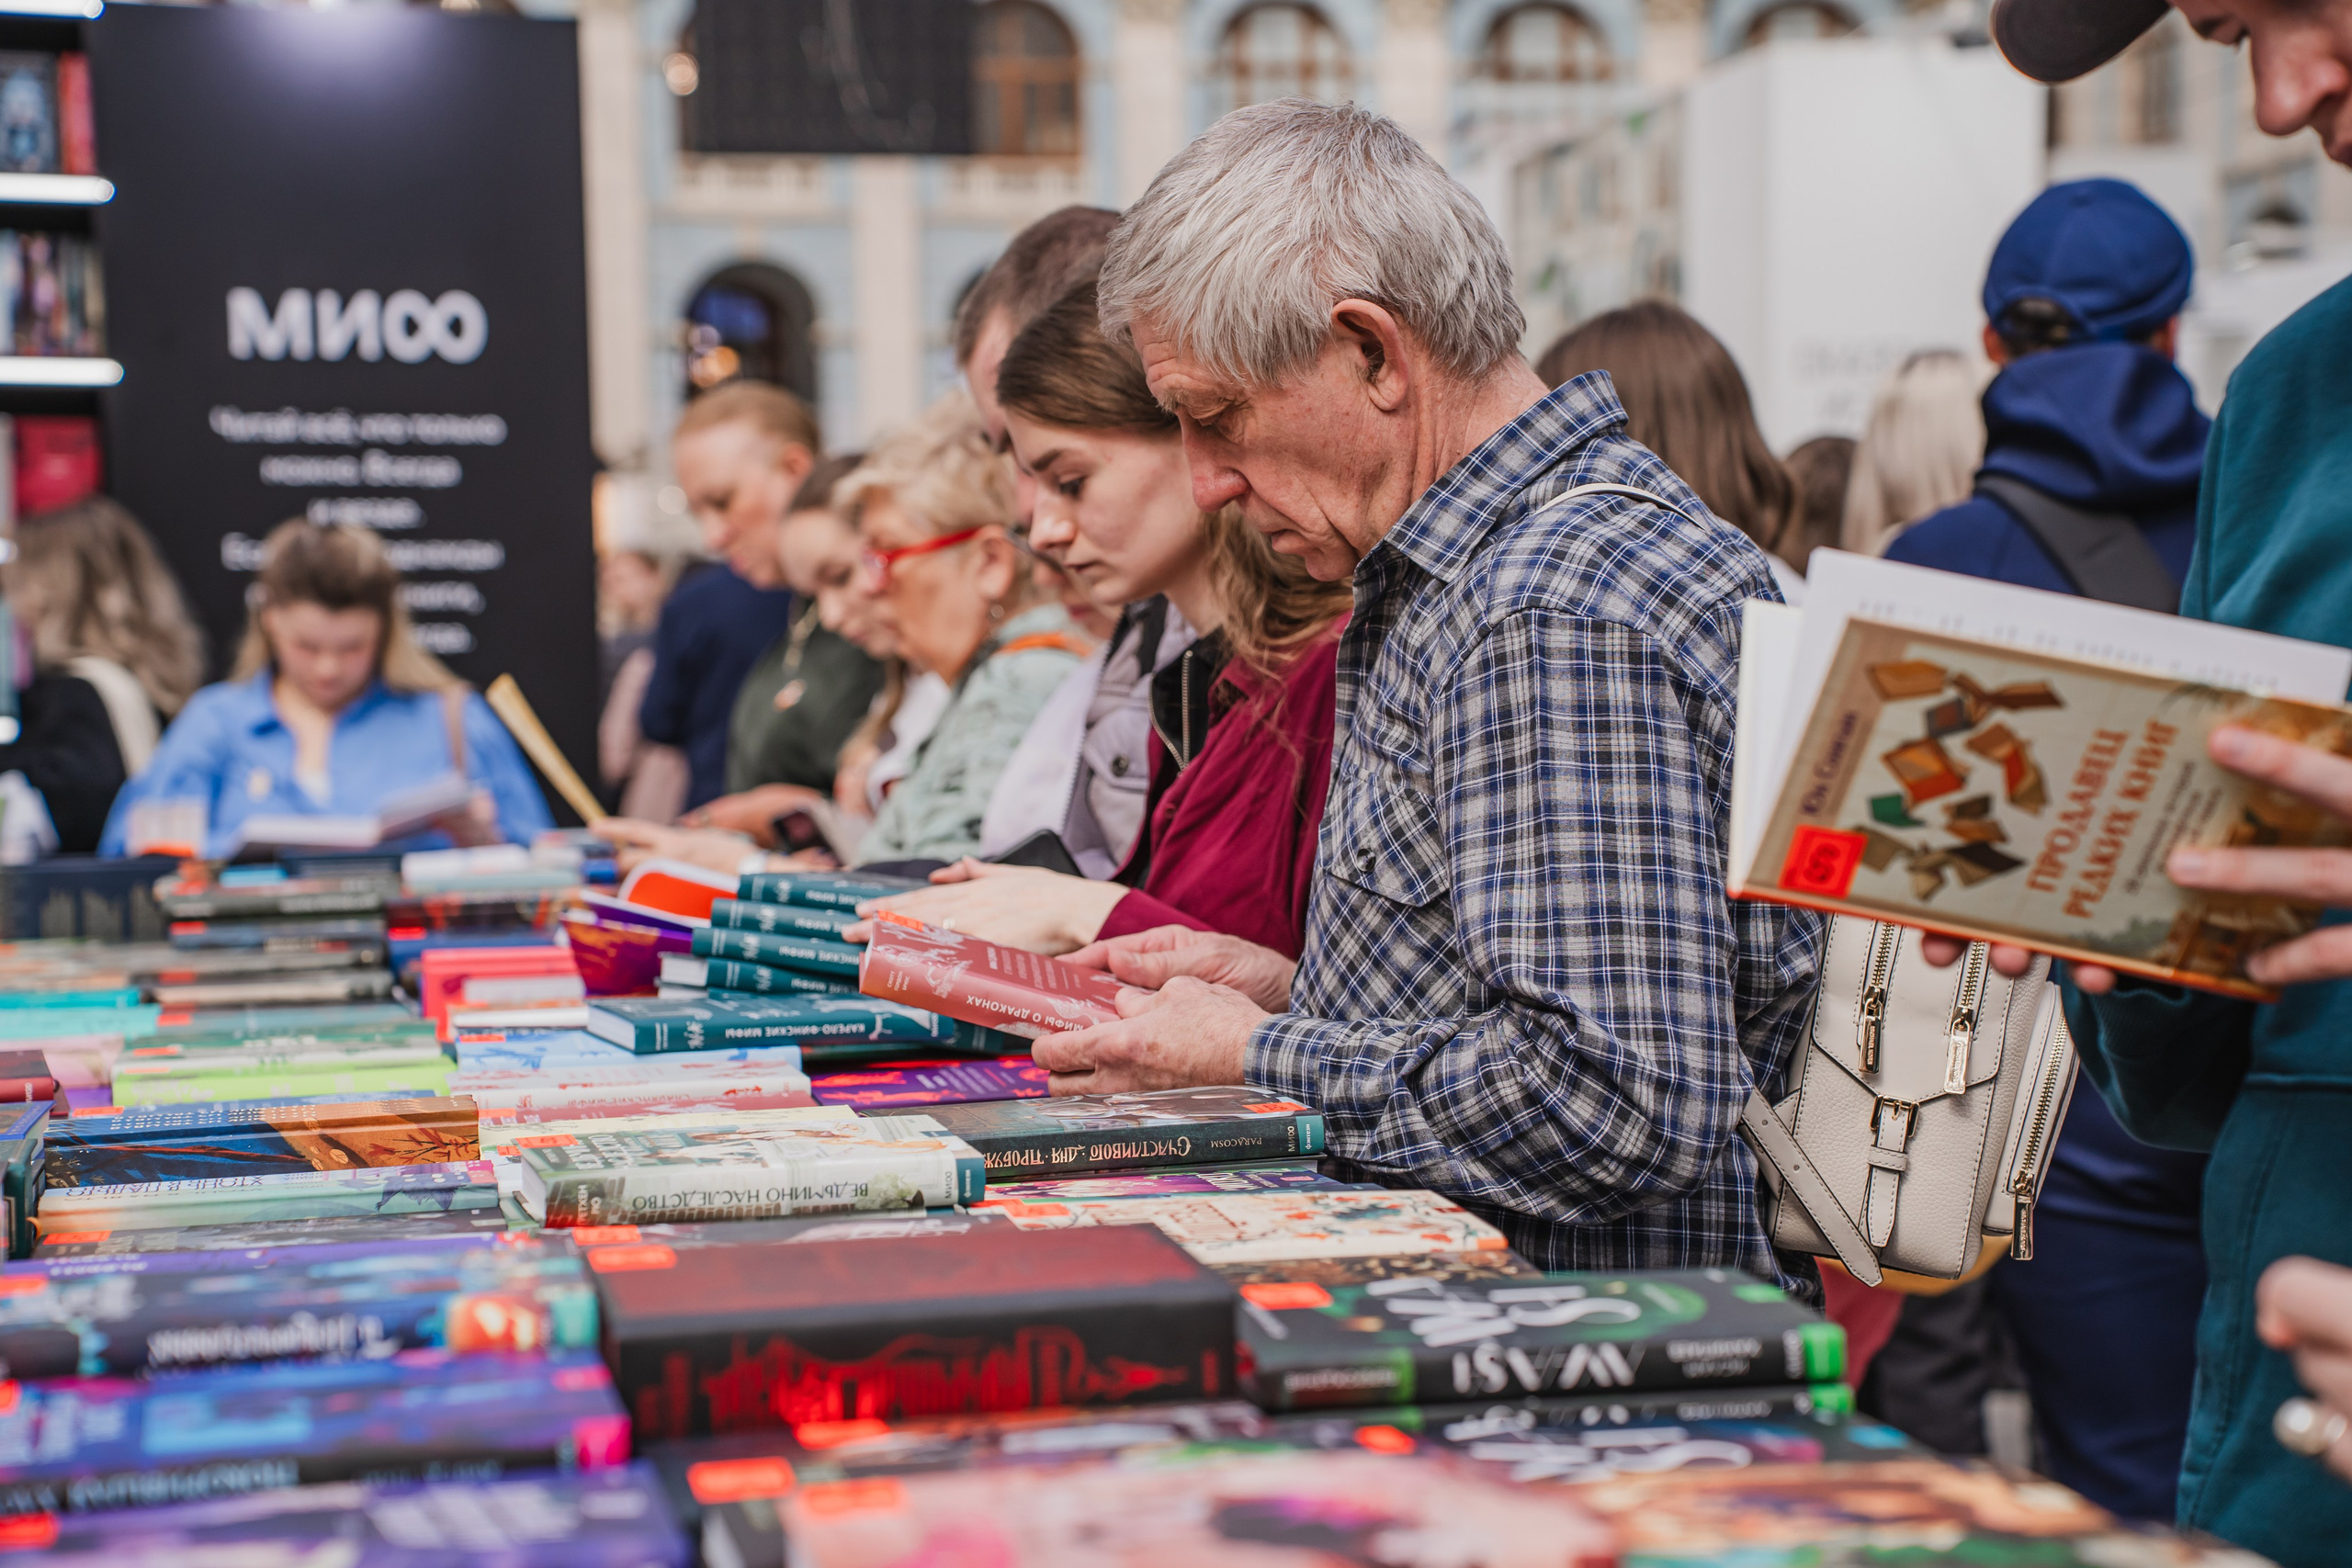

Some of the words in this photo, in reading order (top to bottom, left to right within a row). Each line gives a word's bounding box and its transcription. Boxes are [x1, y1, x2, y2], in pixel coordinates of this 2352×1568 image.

[2028, 728, 2129, 895] ПРОДАВЕЦ
[2064, 808, 2135, 920] РЕДКИХ
[2118, 719, 2178, 804] КНИГ
[778, 945, 817, 961] МИФЫ
[966, 995, 1031, 1020] ДРАКОНАХ
[1033, 1012, 1042, 1021] О
[724, 1025, 764, 1039] МИФЫ
[765, 1022, 866, 1039] КАРЕЛО-ФИНСКИЕ
[1046, 1015, 1083, 1032] МИФЫ
[1090, 1135, 1192, 1161] СЧАСТЛИВОГО
[1209, 1136, 1262, 1148] PARACOSM
[1051, 1145, 1085, 1163] ДНЯ
[632, 1188, 759, 1211] НАСЛЕДСТВО
[765, 1180, 869, 1203] ВЕДЬМИНО
